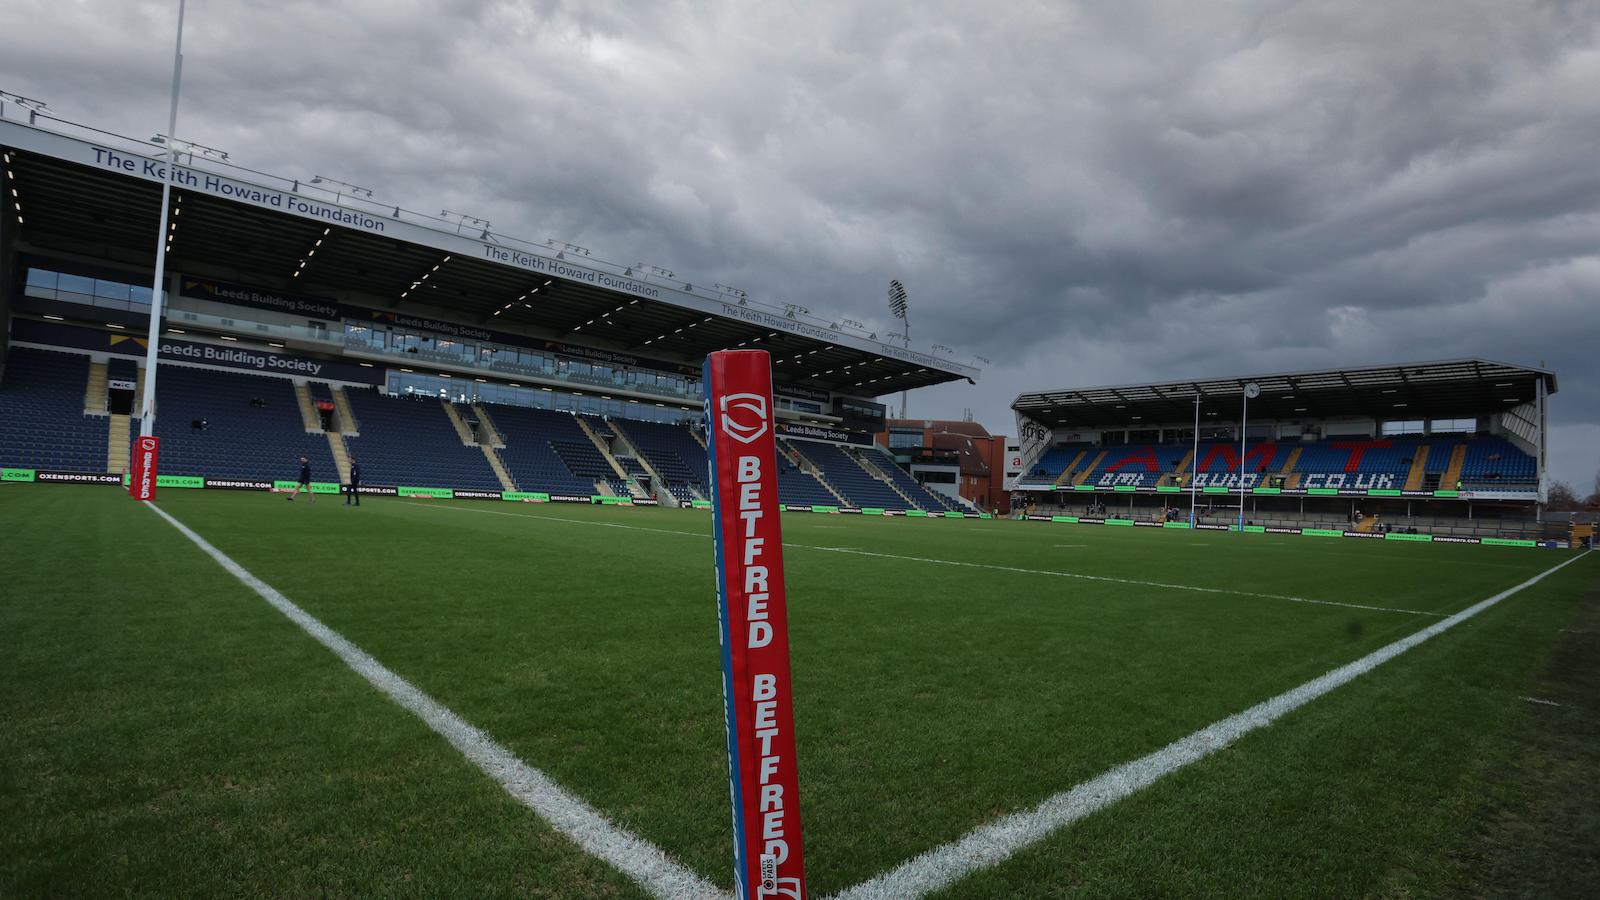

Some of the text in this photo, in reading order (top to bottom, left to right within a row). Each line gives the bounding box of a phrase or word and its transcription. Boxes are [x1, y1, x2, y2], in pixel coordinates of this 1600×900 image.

[92, 147, 384, 232] The Keith Howard Foundation
[484, 245, 658, 297] The Keith Howard Foundation
[214, 285, 337, 317] Leeds Building Society
[394, 316, 492, 341] Leeds Building Society
[721, 304, 838, 342] The Keith Howard Foundation
[204, 347, 265, 368] Building
[268, 355, 322, 375] Society
[786, 424, 849, 441] Leeds Building Society
[39, 473, 121, 483] OXENSPORTS.COM
[140, 452, 152, 499] BETFRED
[206, 480, 272, 489] OXENSPORTS.COM
[454, 491, 501, 499] OXENSPORTS.COM
[737, 455, 774, 649] BETFRED
[753, 673, 789, 866] BETFRED
